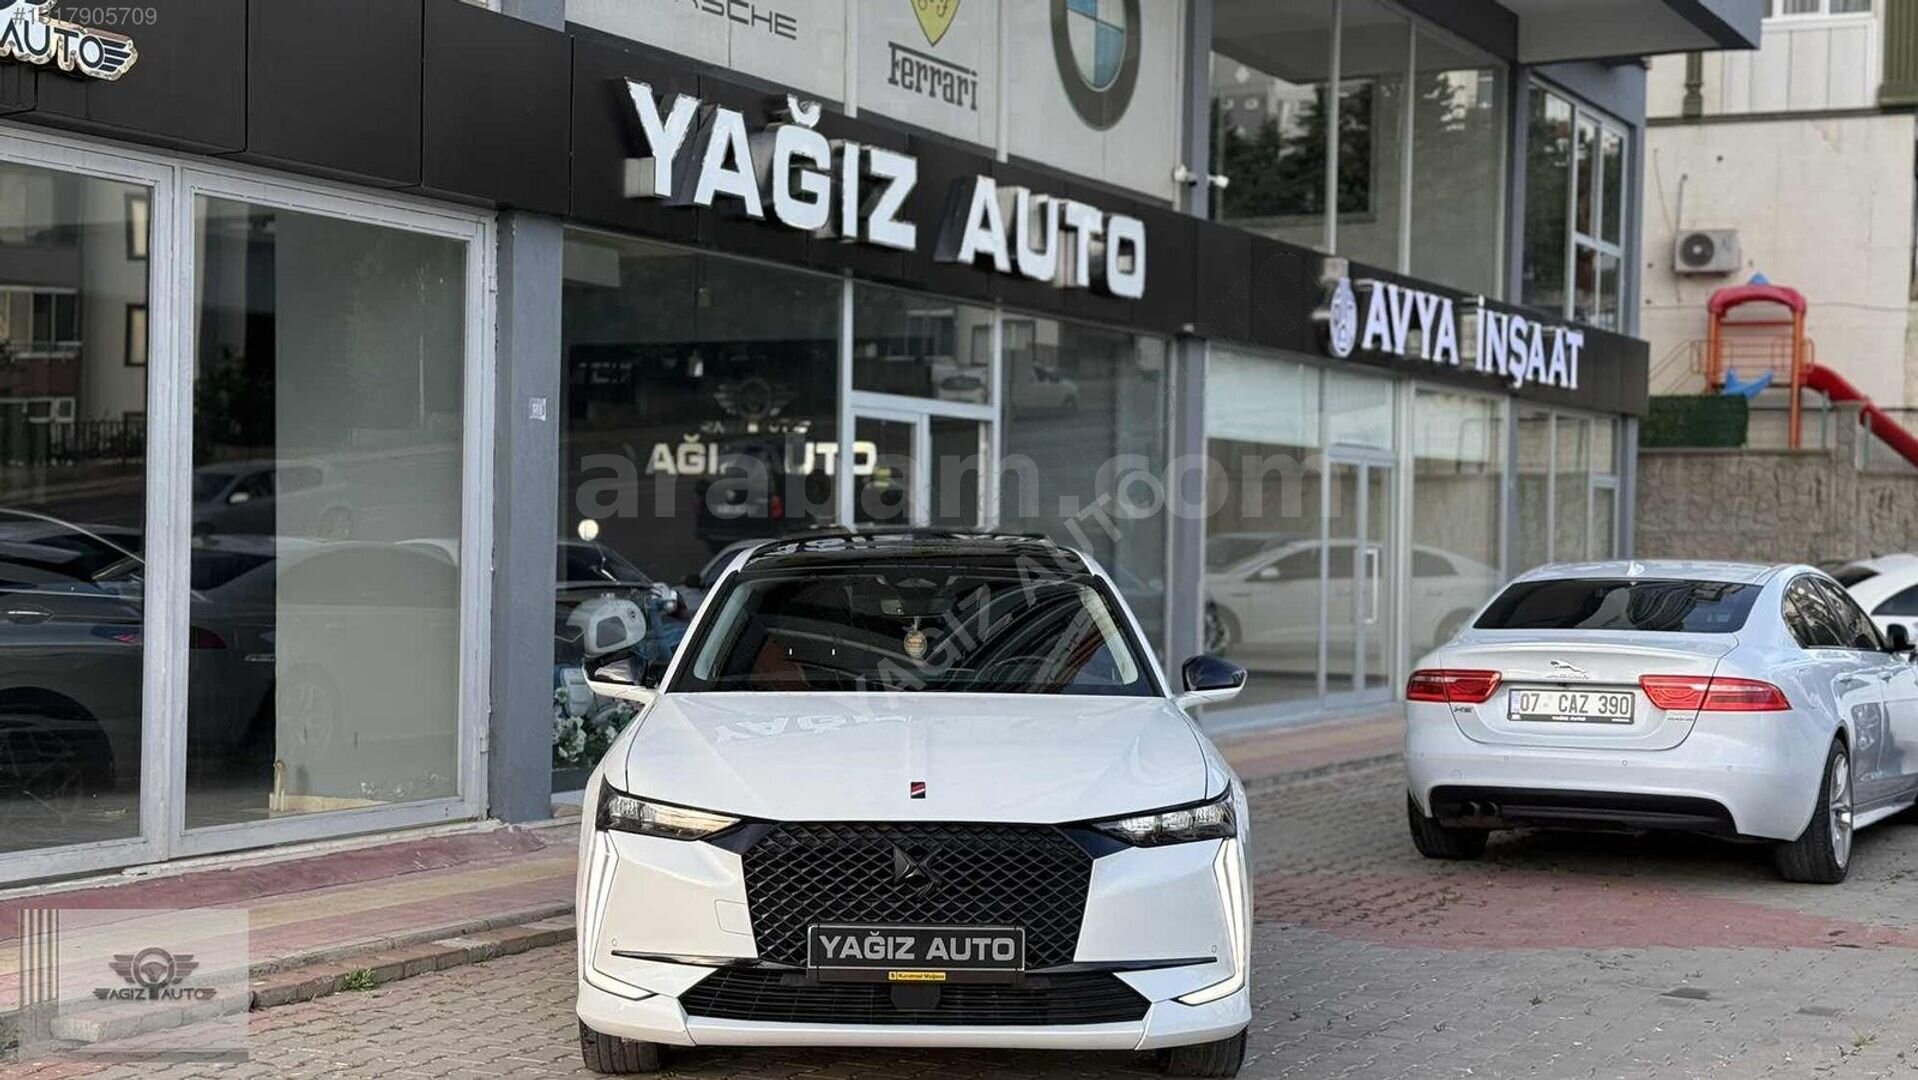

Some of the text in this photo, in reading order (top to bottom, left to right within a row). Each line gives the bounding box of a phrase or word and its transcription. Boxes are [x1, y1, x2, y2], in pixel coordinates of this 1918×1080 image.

[0, 19, 105, 69] AUTO
[887, 41, 978, 111] Ferrari
[624, 77, 1146, 300] YAĞIZ AUTO
[1361, 281, 1584, 390] AVYA İNŞAAT
[1519, 693, 1630, 715] 07 CAZ 390
[819, 931, 1015, 961] YAĞIZ AUTO
